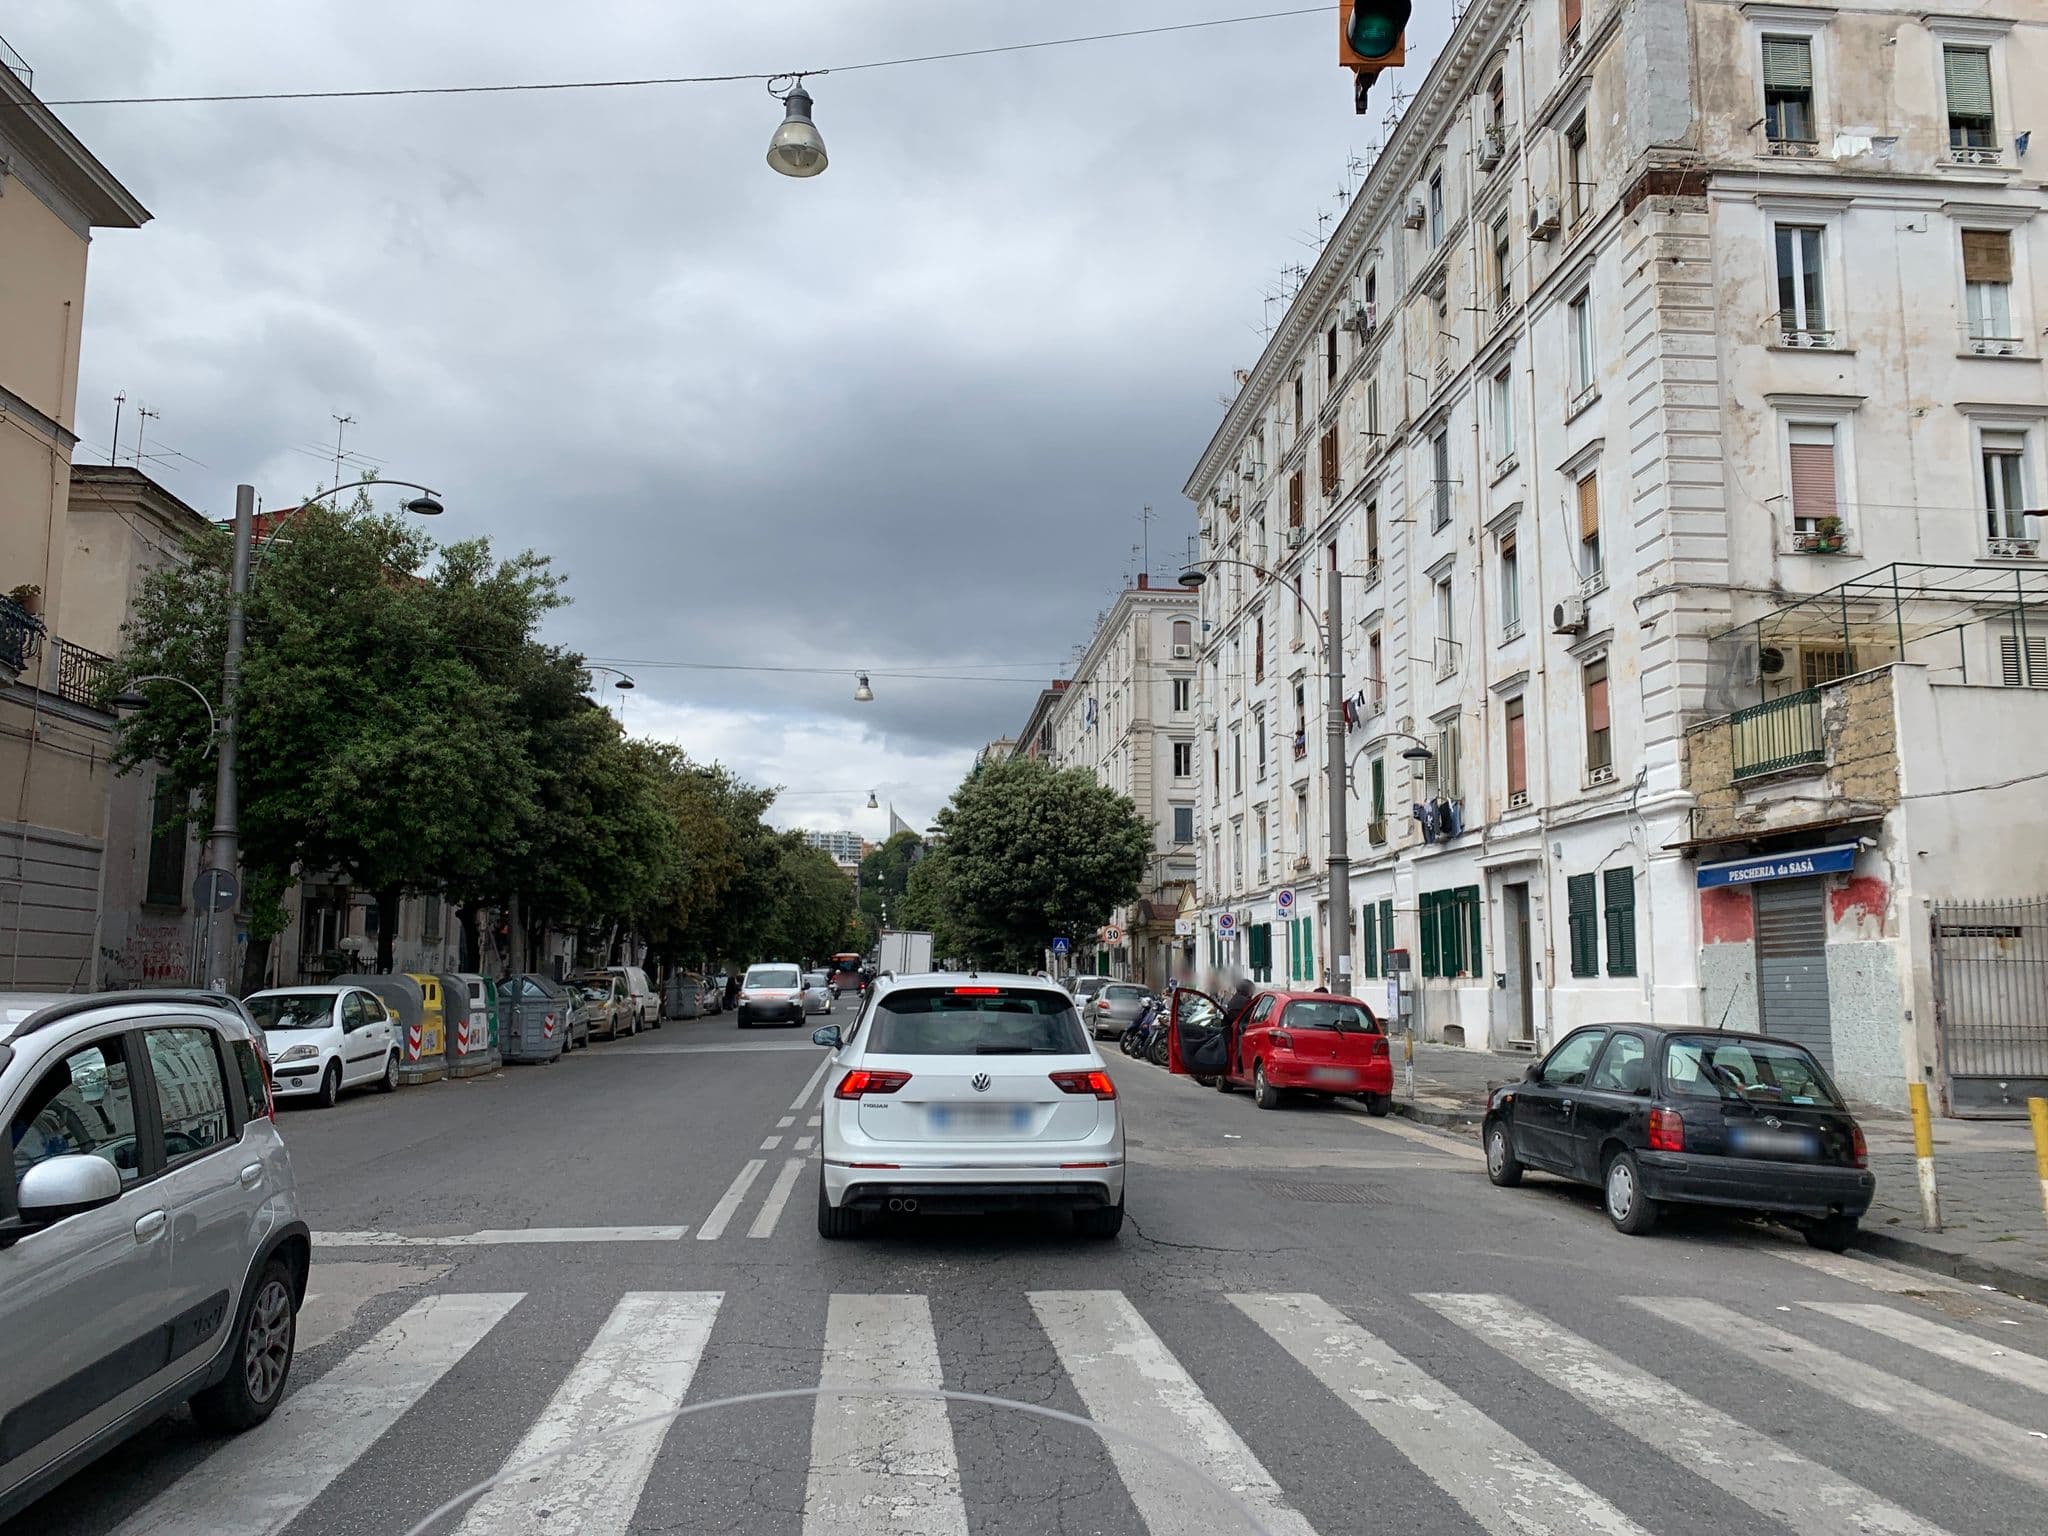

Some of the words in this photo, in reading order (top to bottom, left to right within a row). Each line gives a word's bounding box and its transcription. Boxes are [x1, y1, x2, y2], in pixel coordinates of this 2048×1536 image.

[1729, 866, 1775, 881] PESCHERIA
[1778, 865, 1788, 875] da
[1107, 930, 1118, 939] 30
